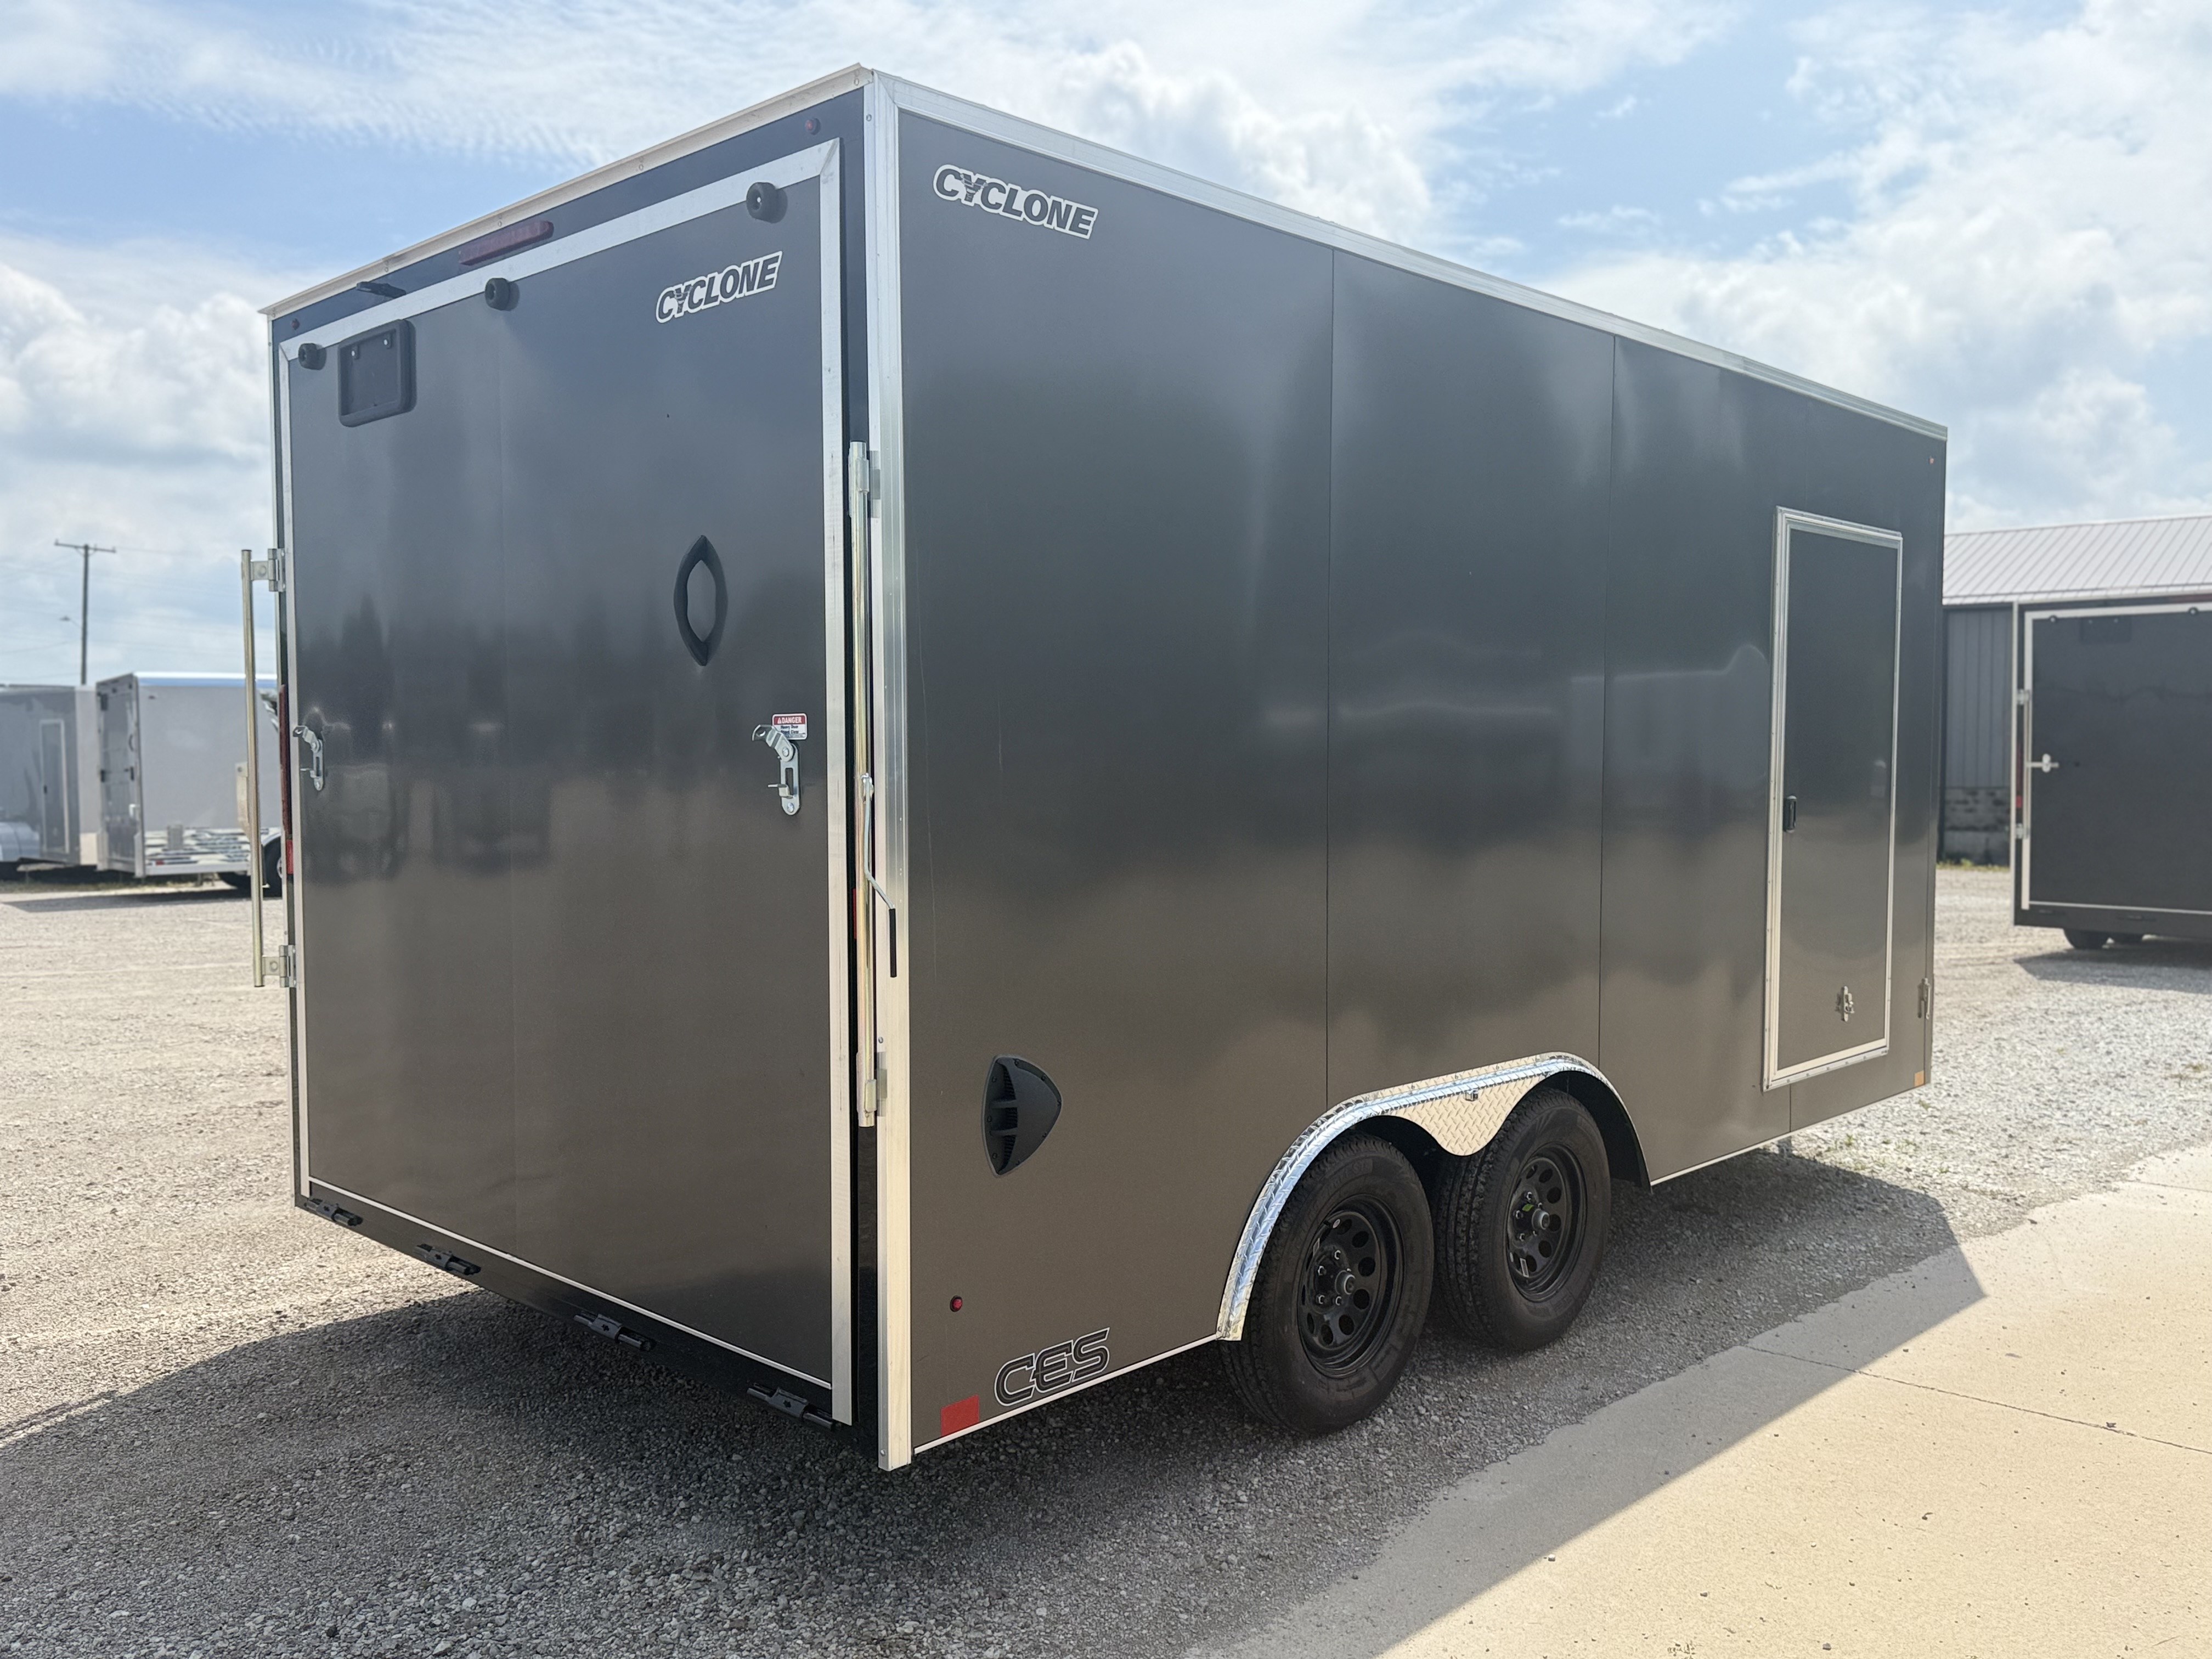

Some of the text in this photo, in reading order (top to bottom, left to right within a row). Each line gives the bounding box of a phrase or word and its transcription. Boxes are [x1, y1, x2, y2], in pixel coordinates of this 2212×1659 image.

[933, 165, 1098, 239] CYCLONE
[656, 251, 782, 323] CYCLONE
[994, 1327, 1110, 1406] CES
